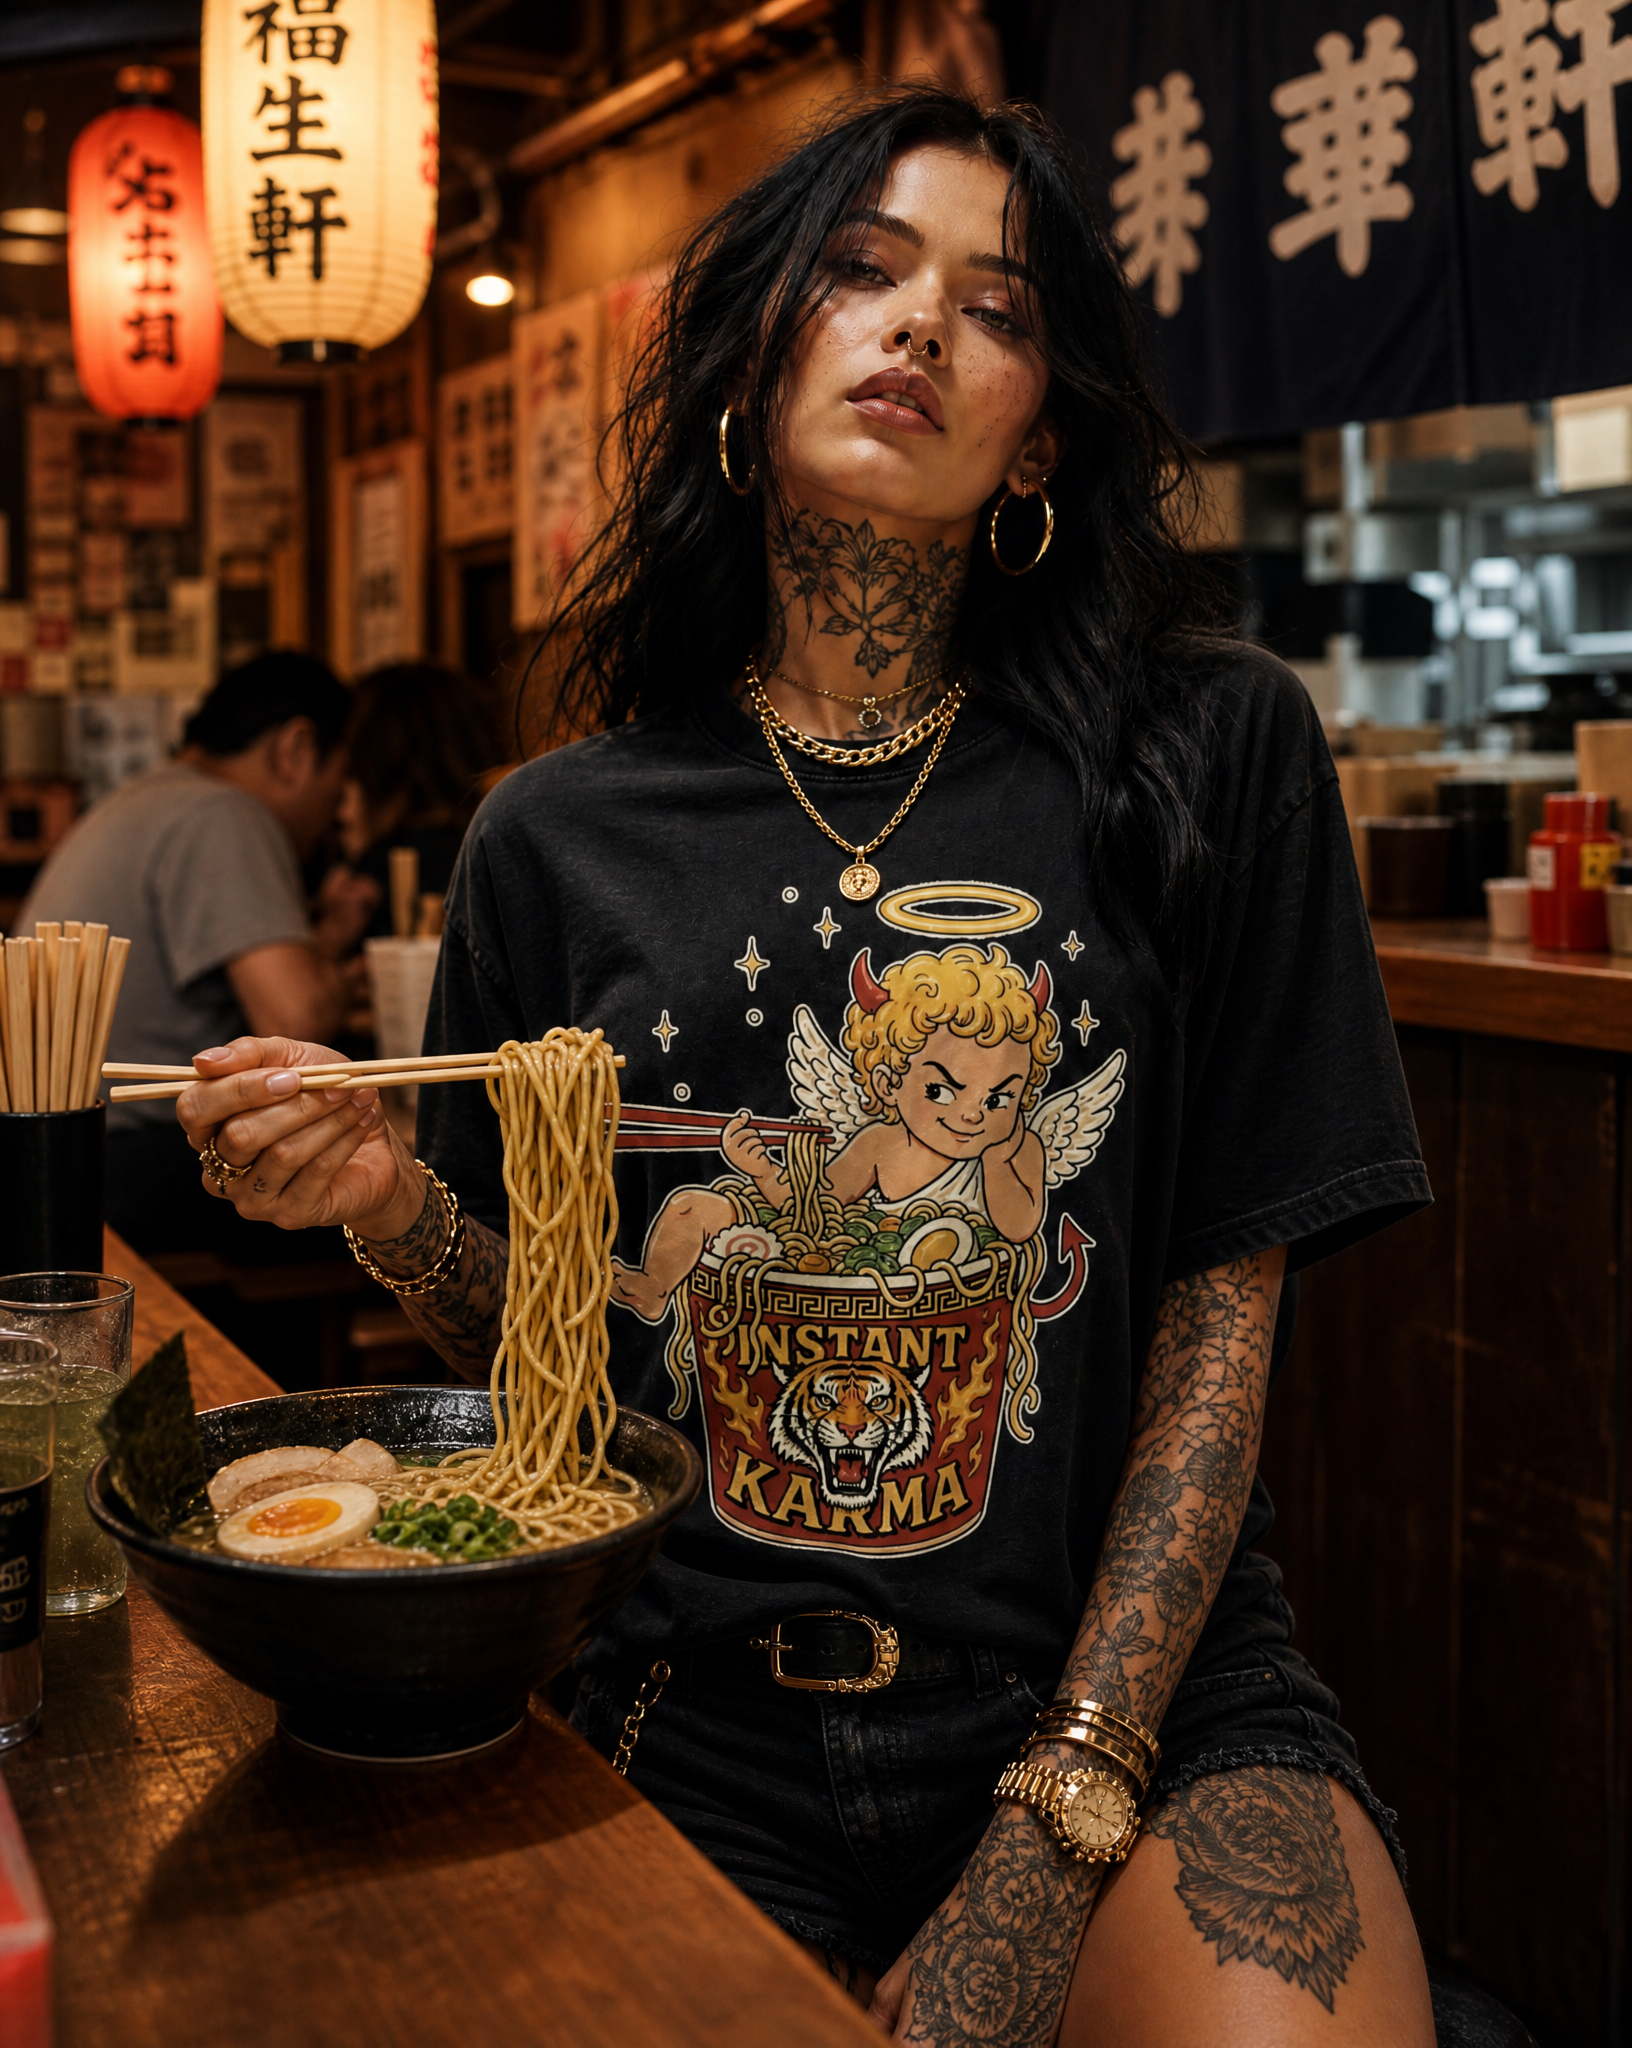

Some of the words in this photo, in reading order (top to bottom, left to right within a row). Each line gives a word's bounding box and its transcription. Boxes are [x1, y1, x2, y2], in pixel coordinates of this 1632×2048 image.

[241, 0, 349, 281] 福生軒
[736, 1323, 967, 1369] INSTANT
